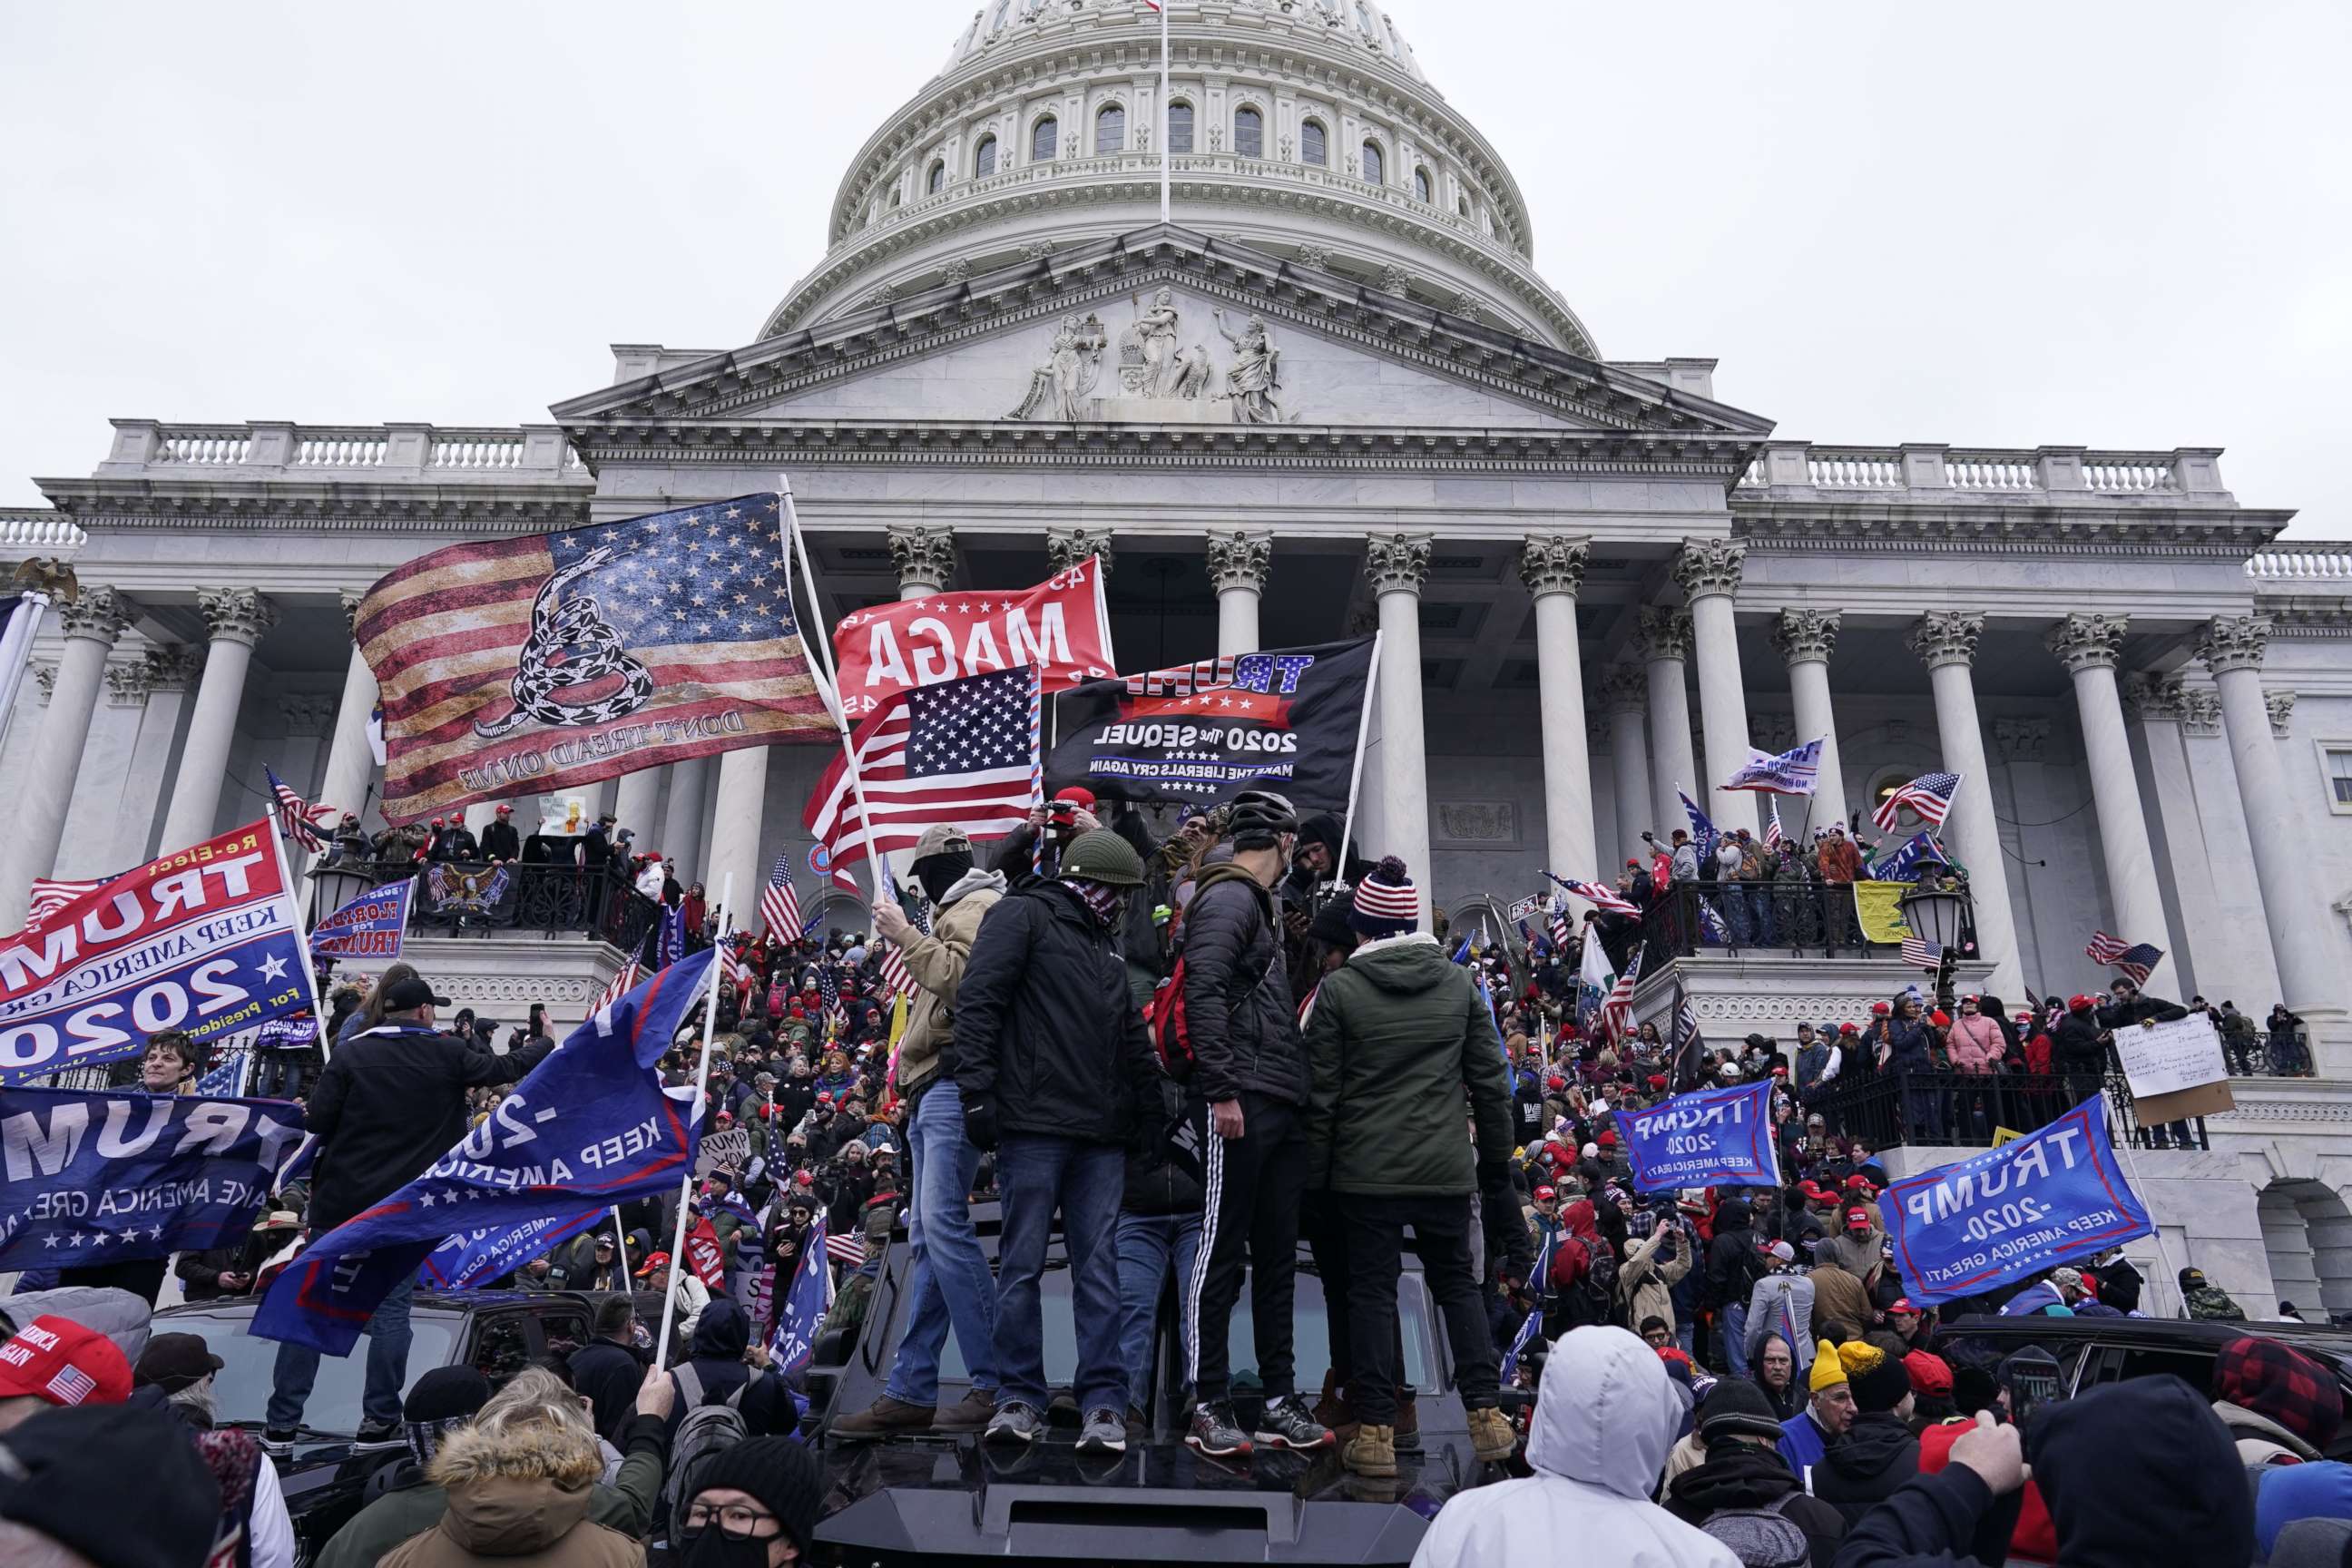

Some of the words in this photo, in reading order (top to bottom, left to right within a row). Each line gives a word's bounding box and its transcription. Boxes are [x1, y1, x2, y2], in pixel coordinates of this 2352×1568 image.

[261, 1026, 312, 1036] SWAMP
[700, 1132, 747, 1154] RUMP
[15, 1323, 61, 1352] MERICA
[1692, 1377, 1719, 1392] TRUMP
